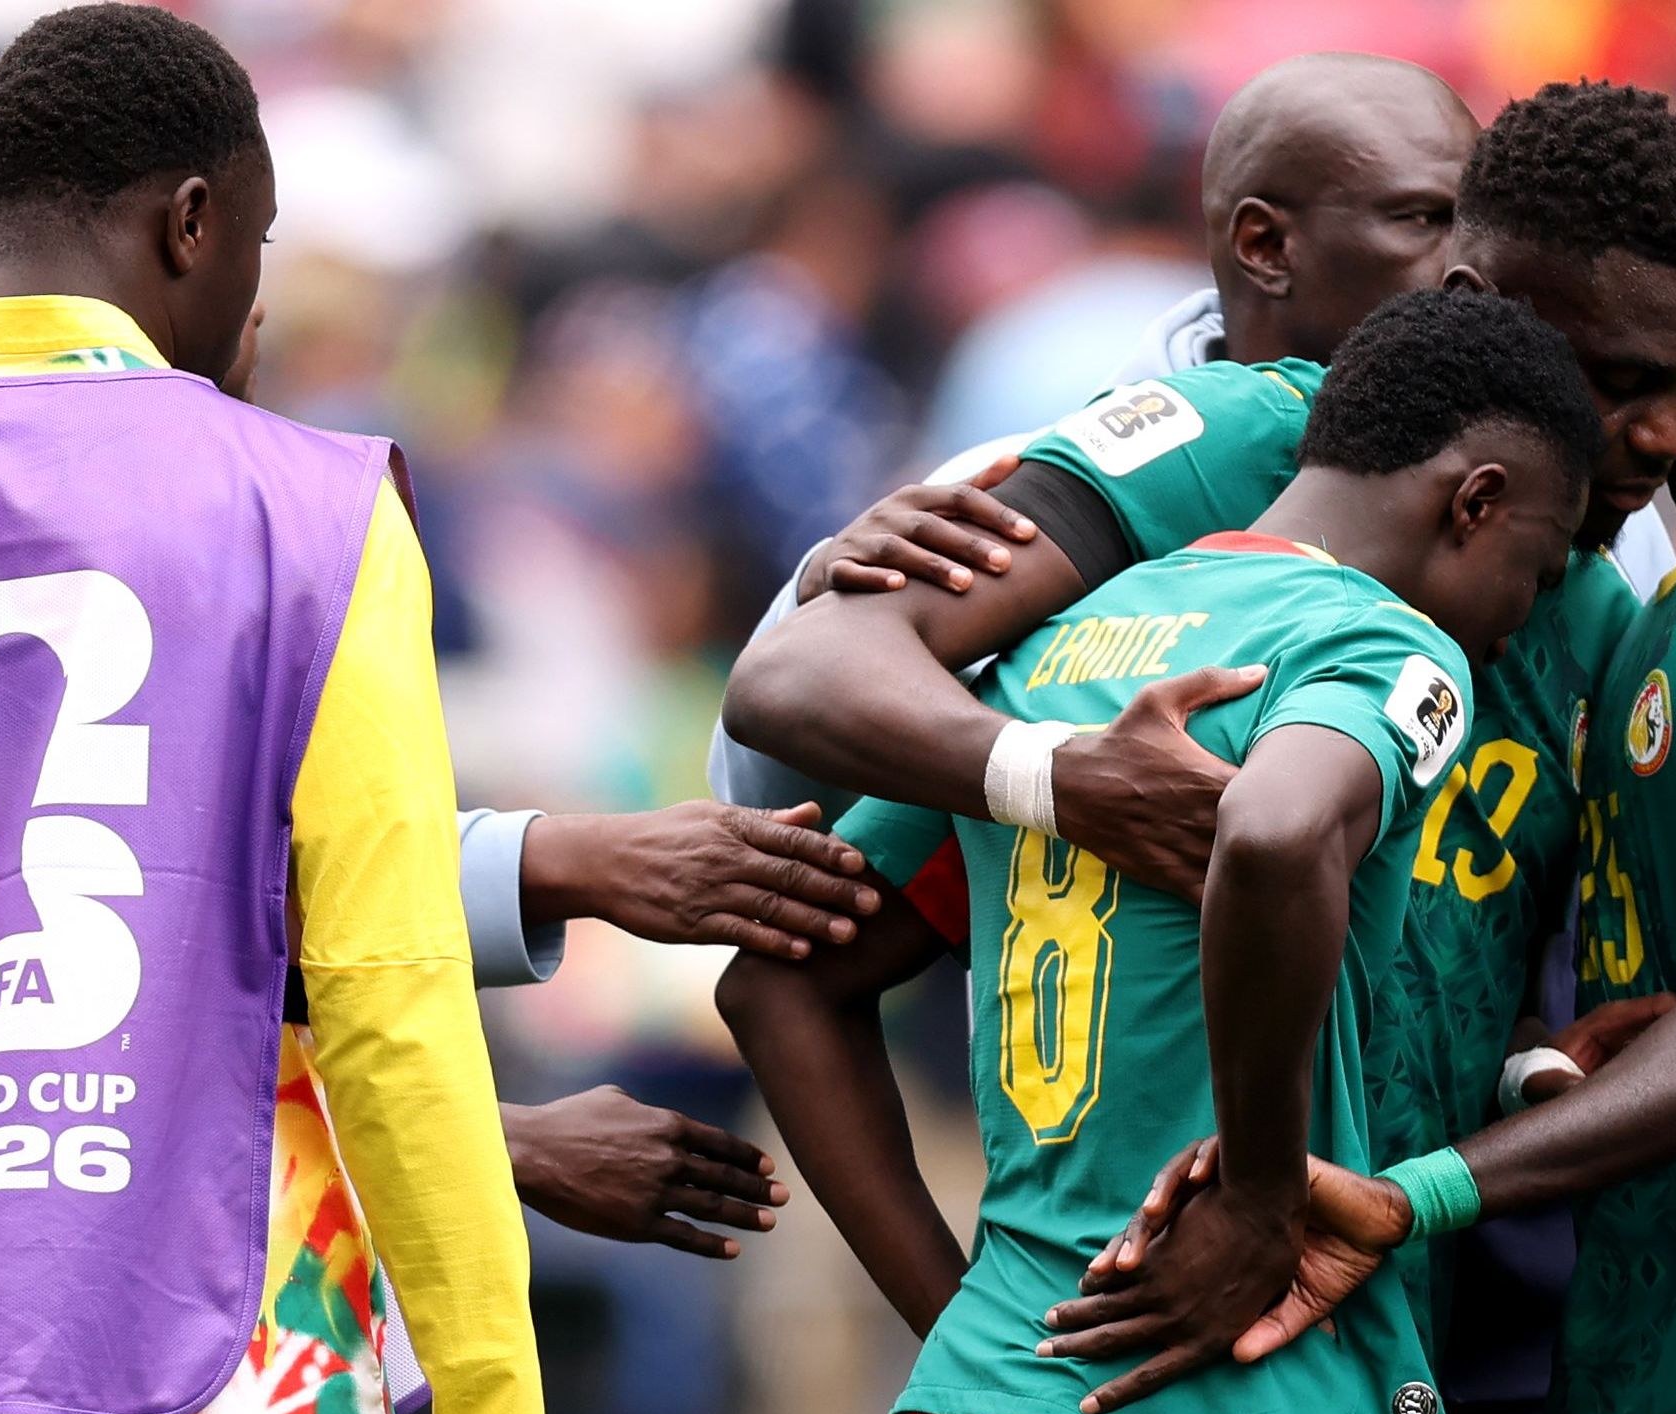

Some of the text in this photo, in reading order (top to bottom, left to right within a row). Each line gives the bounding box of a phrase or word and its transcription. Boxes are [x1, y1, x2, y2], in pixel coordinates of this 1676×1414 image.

[1026, 611, 1210, 692] LAMINE
[1412, 738, 1539, 902] 19
[999, 724, 1120, 1145] 8
[28, 1072, 136, 1114] CUP
